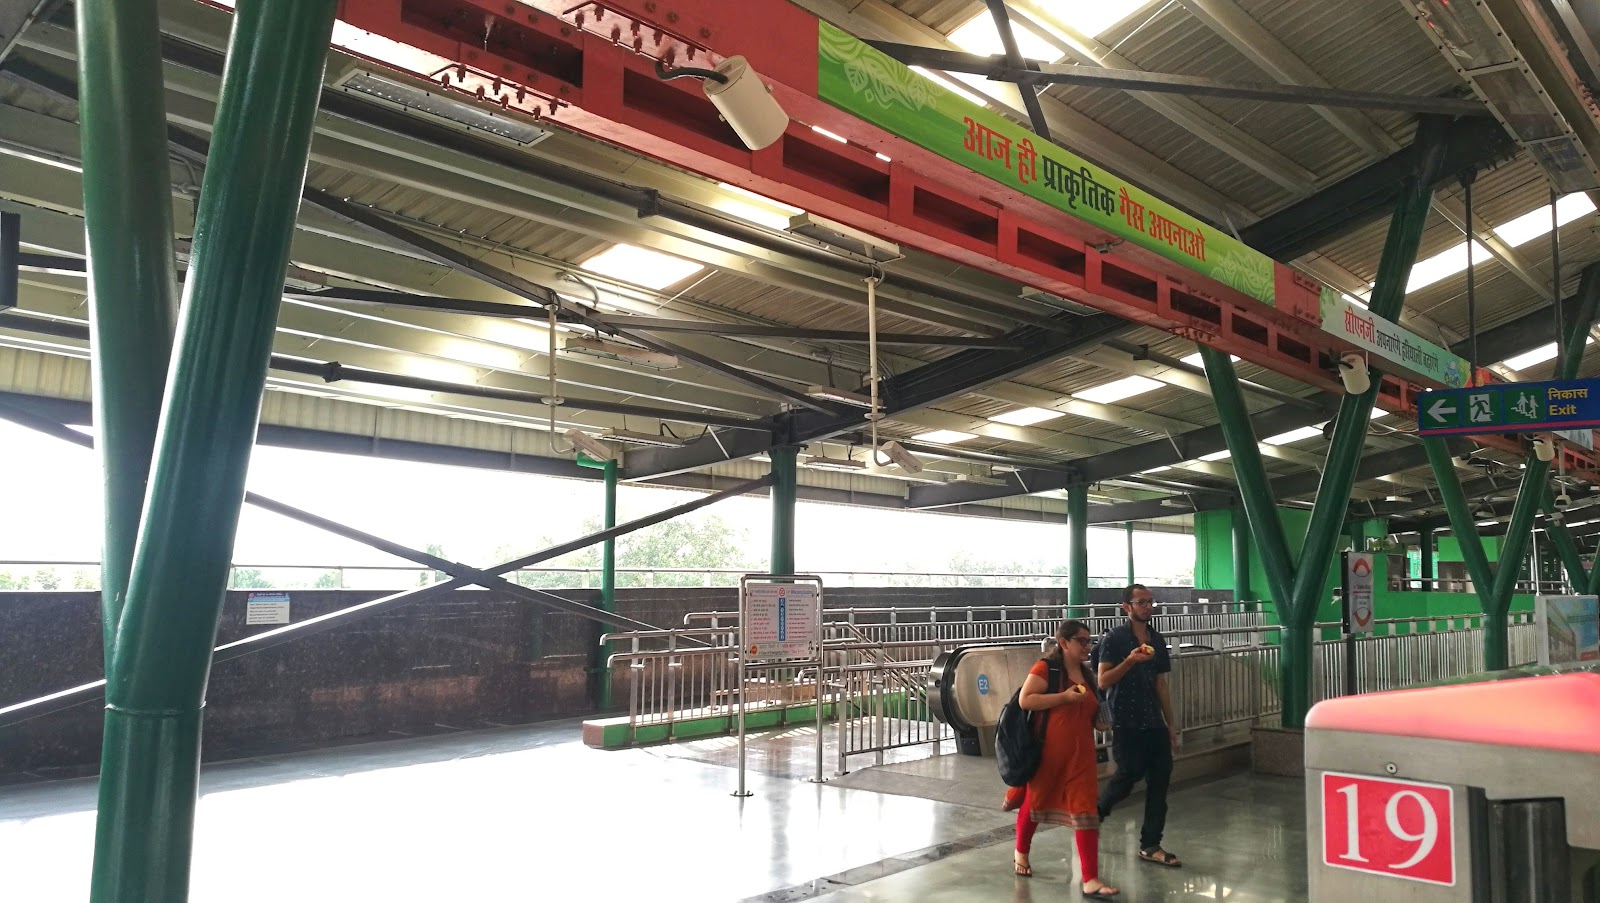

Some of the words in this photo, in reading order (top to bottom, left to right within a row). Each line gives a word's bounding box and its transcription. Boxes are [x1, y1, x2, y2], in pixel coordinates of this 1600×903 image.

[963, 116, 1012, 169] आज
[1016, 138, 1037, 184] ही
[1042, 155, 1115, 216] प्राकृतिक
[1119, 187, 1145, 232] गैस
[1149, 210, 1206, 262] अपनाओ
[1345, 306, 1375, 344] सीएनजी
[1402, 339, 1422, 365] हरियाली
[1548, 387, 1588, 400] निकास
[1549, 404, 1577, 416] Exit
[979, 679, 988, 690] E2
[1336, 783, 1438, 869] 19
